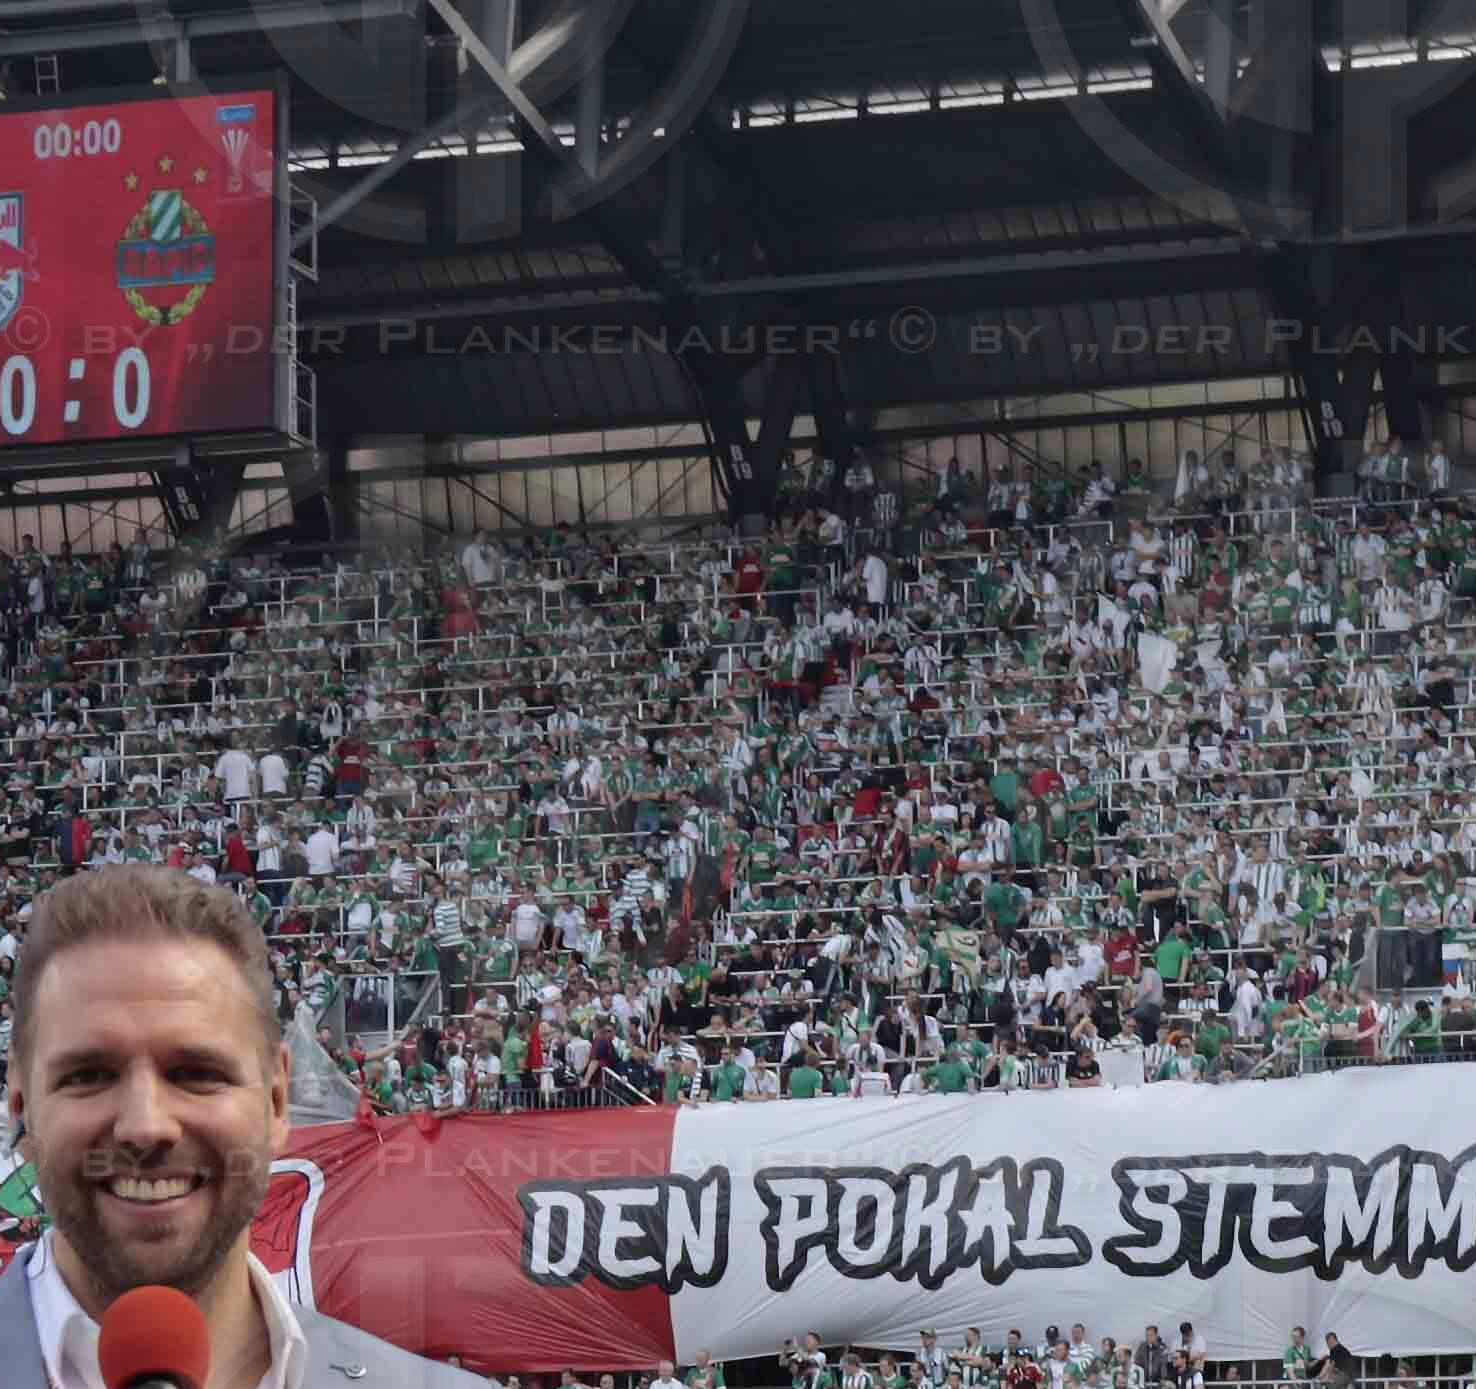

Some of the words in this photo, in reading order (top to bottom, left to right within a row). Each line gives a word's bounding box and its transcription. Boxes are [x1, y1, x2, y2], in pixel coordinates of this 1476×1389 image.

[34, 119, 122, 160] 00:00
[528, 1173, 725, 1290] DEN
[762, 1164, 1081, 1282] POKAL
